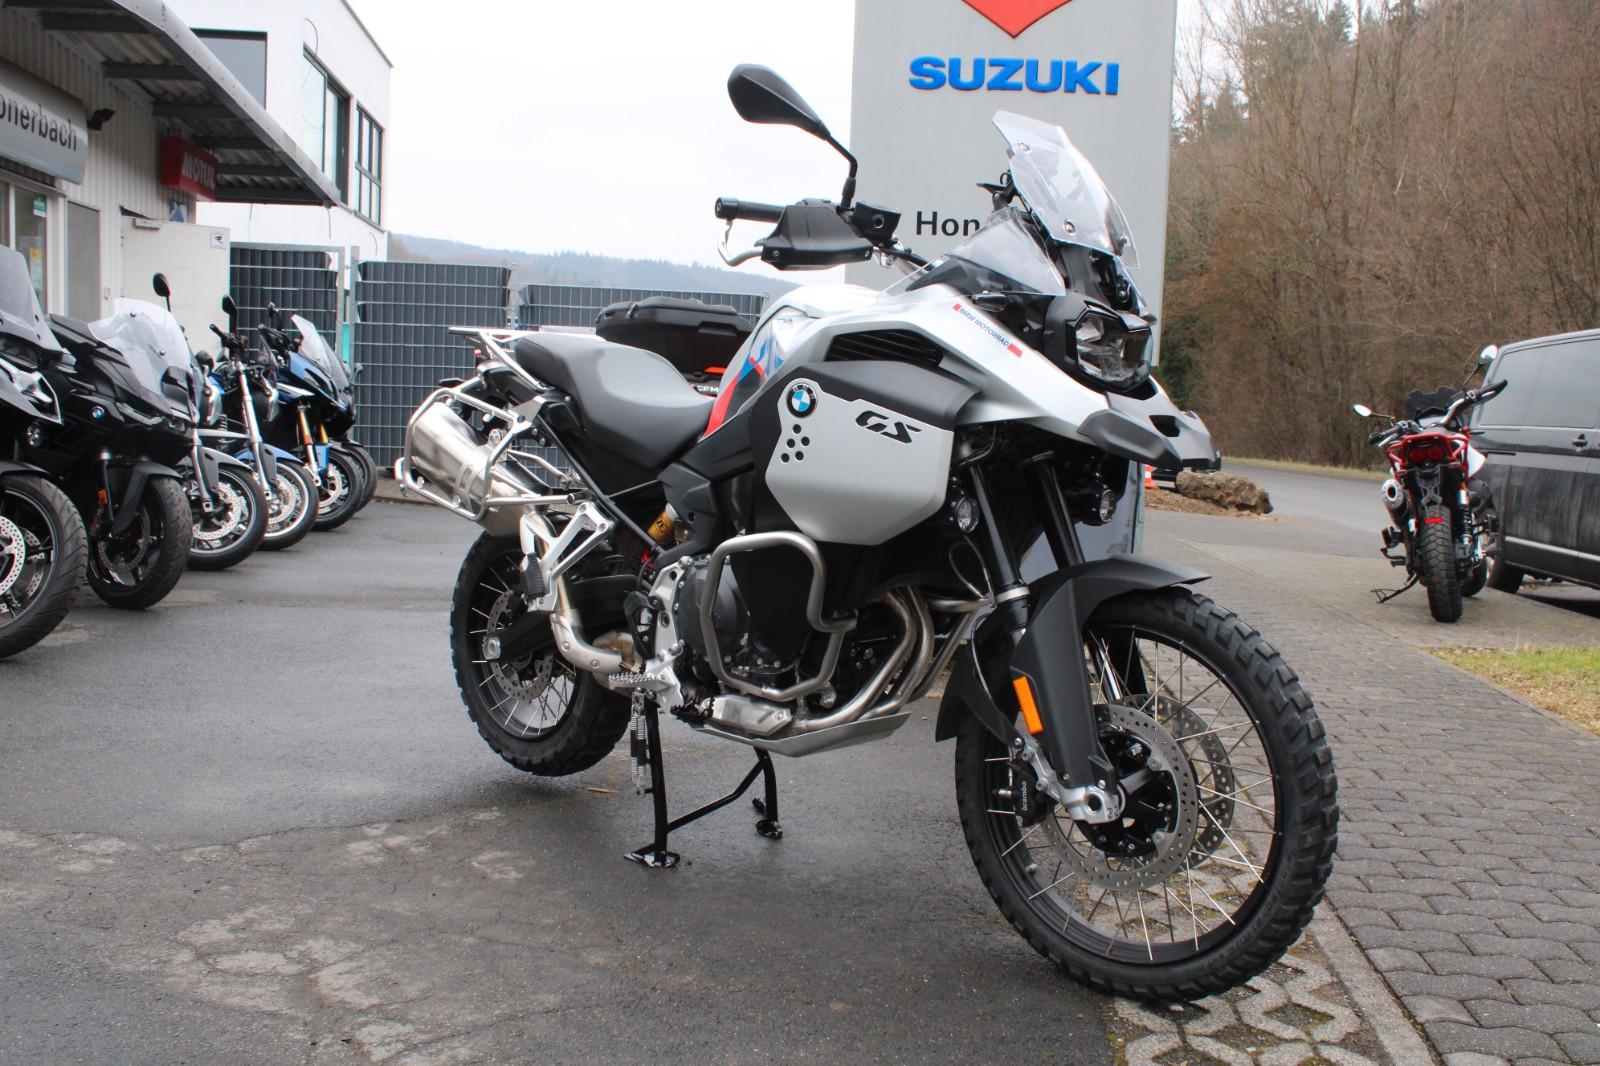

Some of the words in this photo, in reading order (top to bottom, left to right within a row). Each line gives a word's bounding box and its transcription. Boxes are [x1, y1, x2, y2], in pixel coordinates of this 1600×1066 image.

[908, 55, 1120, 96] SUZUKI
[959, 308, 976, 321] BMW
[974, 319, 1010, 347] MOTORRAD
[855, 410, 923, 444] GS
